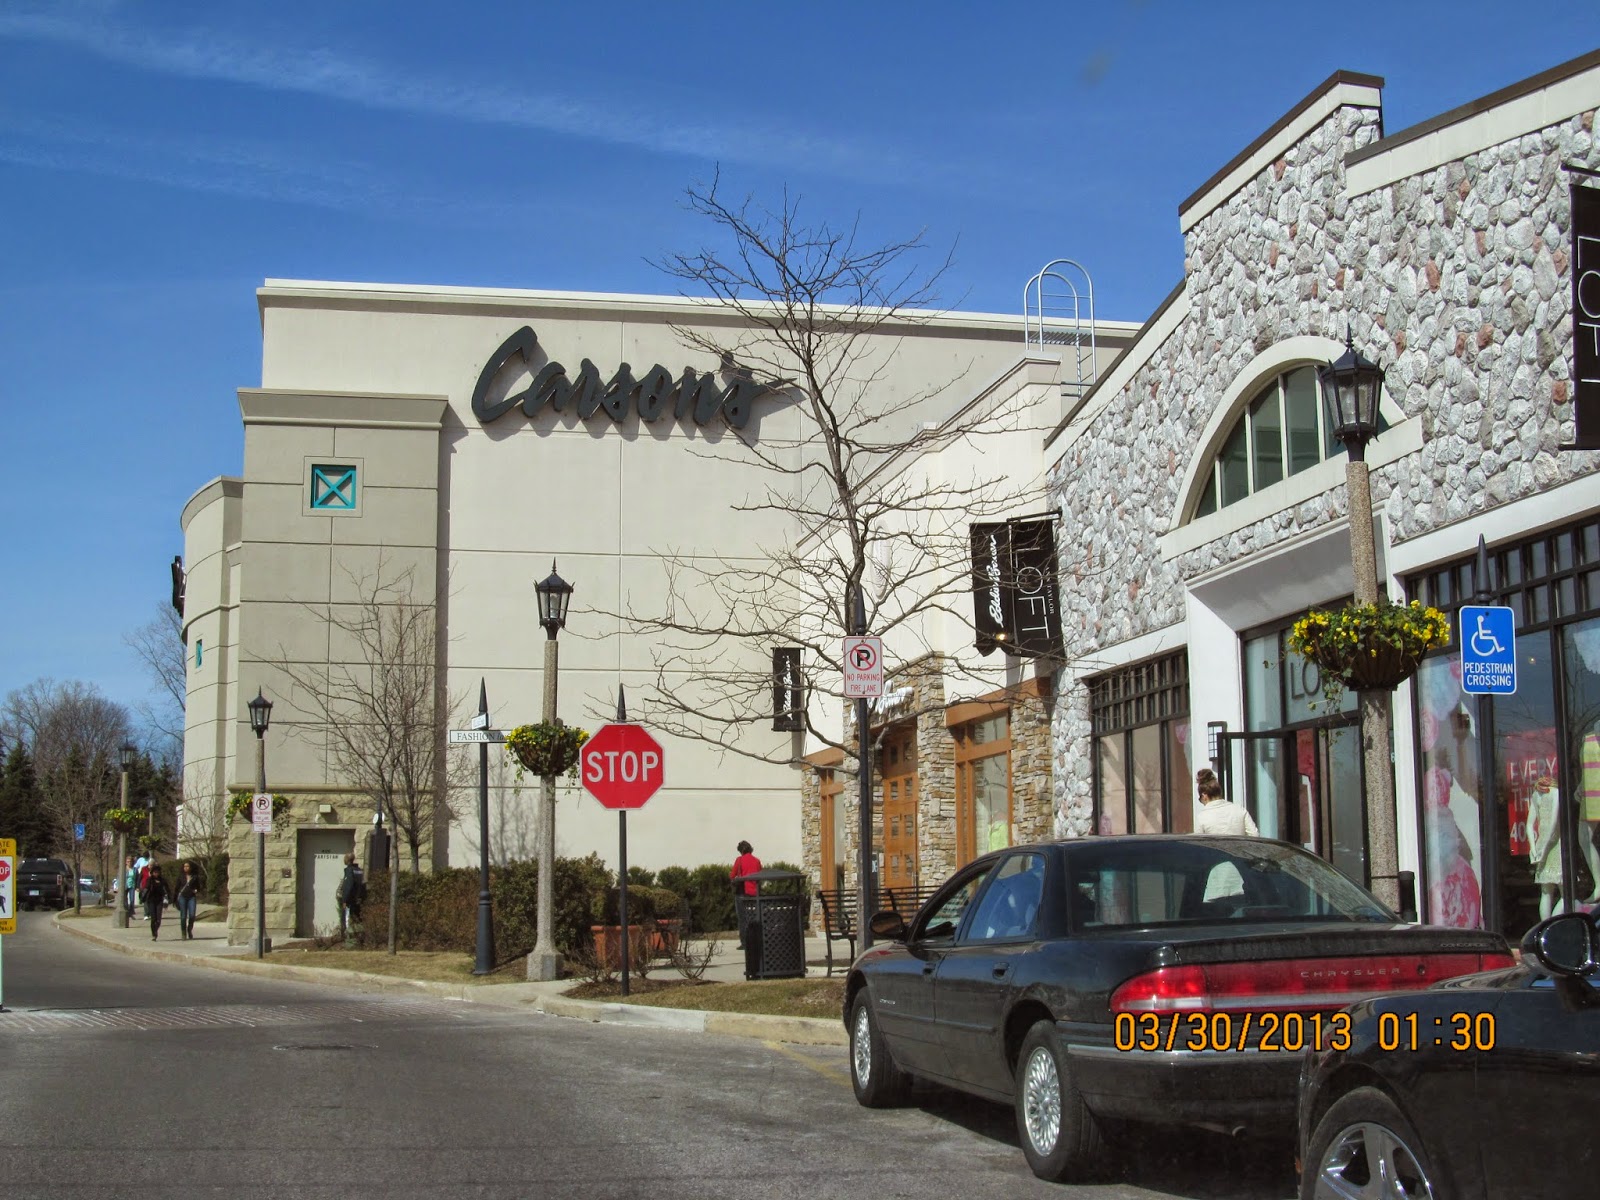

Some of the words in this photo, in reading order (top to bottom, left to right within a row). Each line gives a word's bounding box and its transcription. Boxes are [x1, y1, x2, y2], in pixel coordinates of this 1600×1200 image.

[1015, 548, 1050, 639] LOFT
[1464, 662, 1514, 674] PEDESTRIAN
[847, 673, 855, 681] NO
[857, 673, 880, 682] PARKING
[1290, 660, 1321, 699] LO
[1466, 674, 1512, 687] CROSSING
[851, 684, 861, 692] FIRE
[864, 684, 877, 692] LANE
[457, 732, 495, 741] FASHION
[586, 750, 659, 783] STOP
[1510, 757, 1557, 786] EVERY
[1510, 821, 1538, 843] 40
[1300, 967, 1400, 978] CHRYSLER
